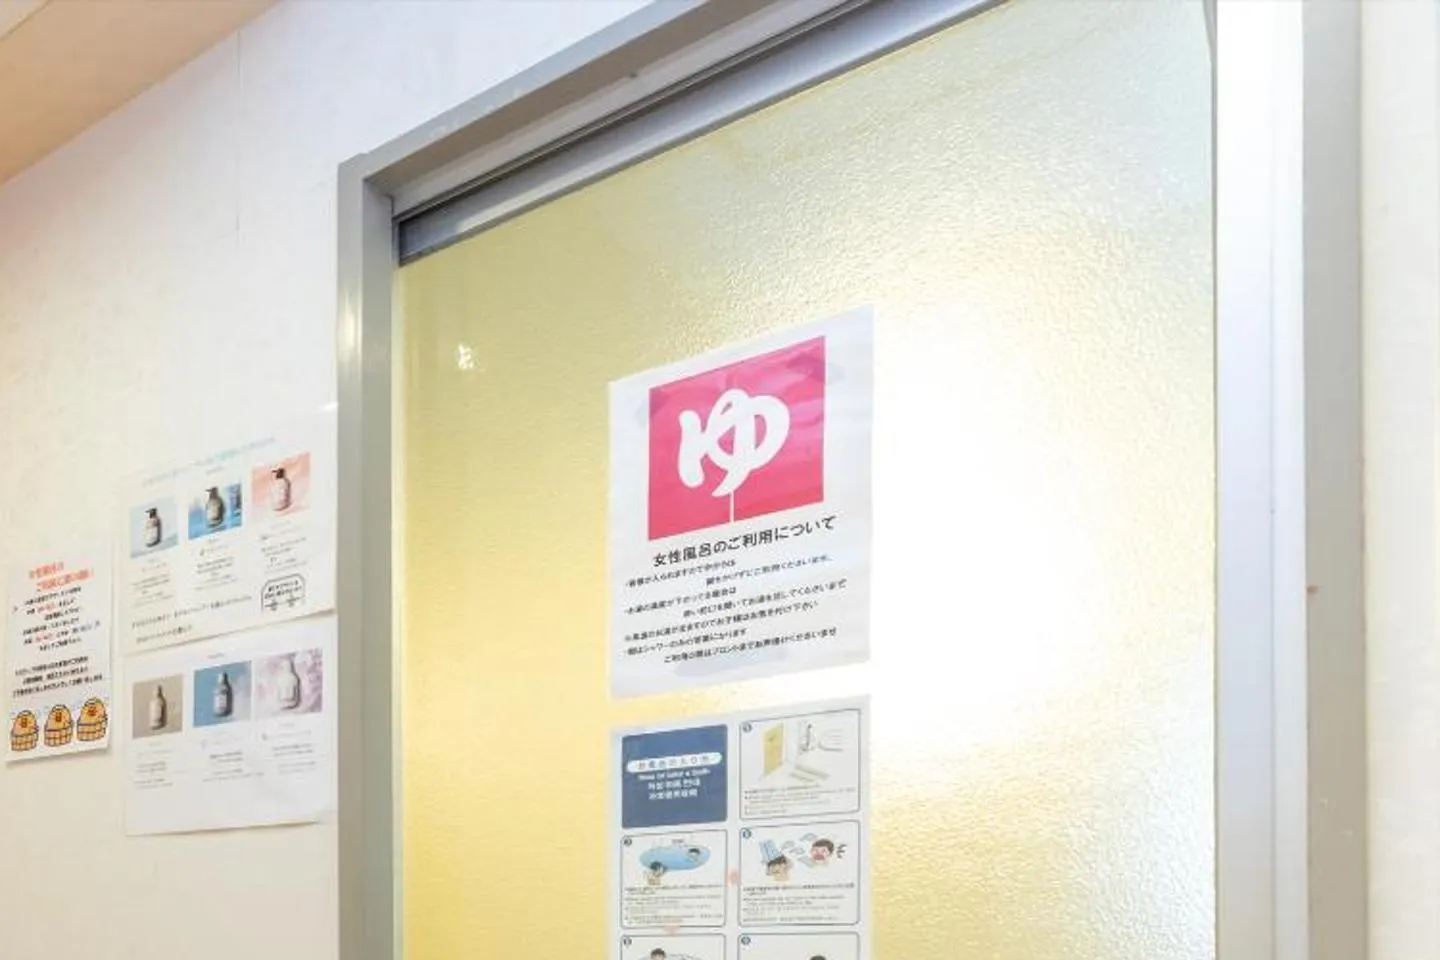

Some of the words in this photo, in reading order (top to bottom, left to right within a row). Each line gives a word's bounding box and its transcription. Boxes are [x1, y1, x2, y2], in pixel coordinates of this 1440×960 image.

[678, 388, 791, 497] ゆ
[652, 515, 837, 567] 女性風呂のご利用について
